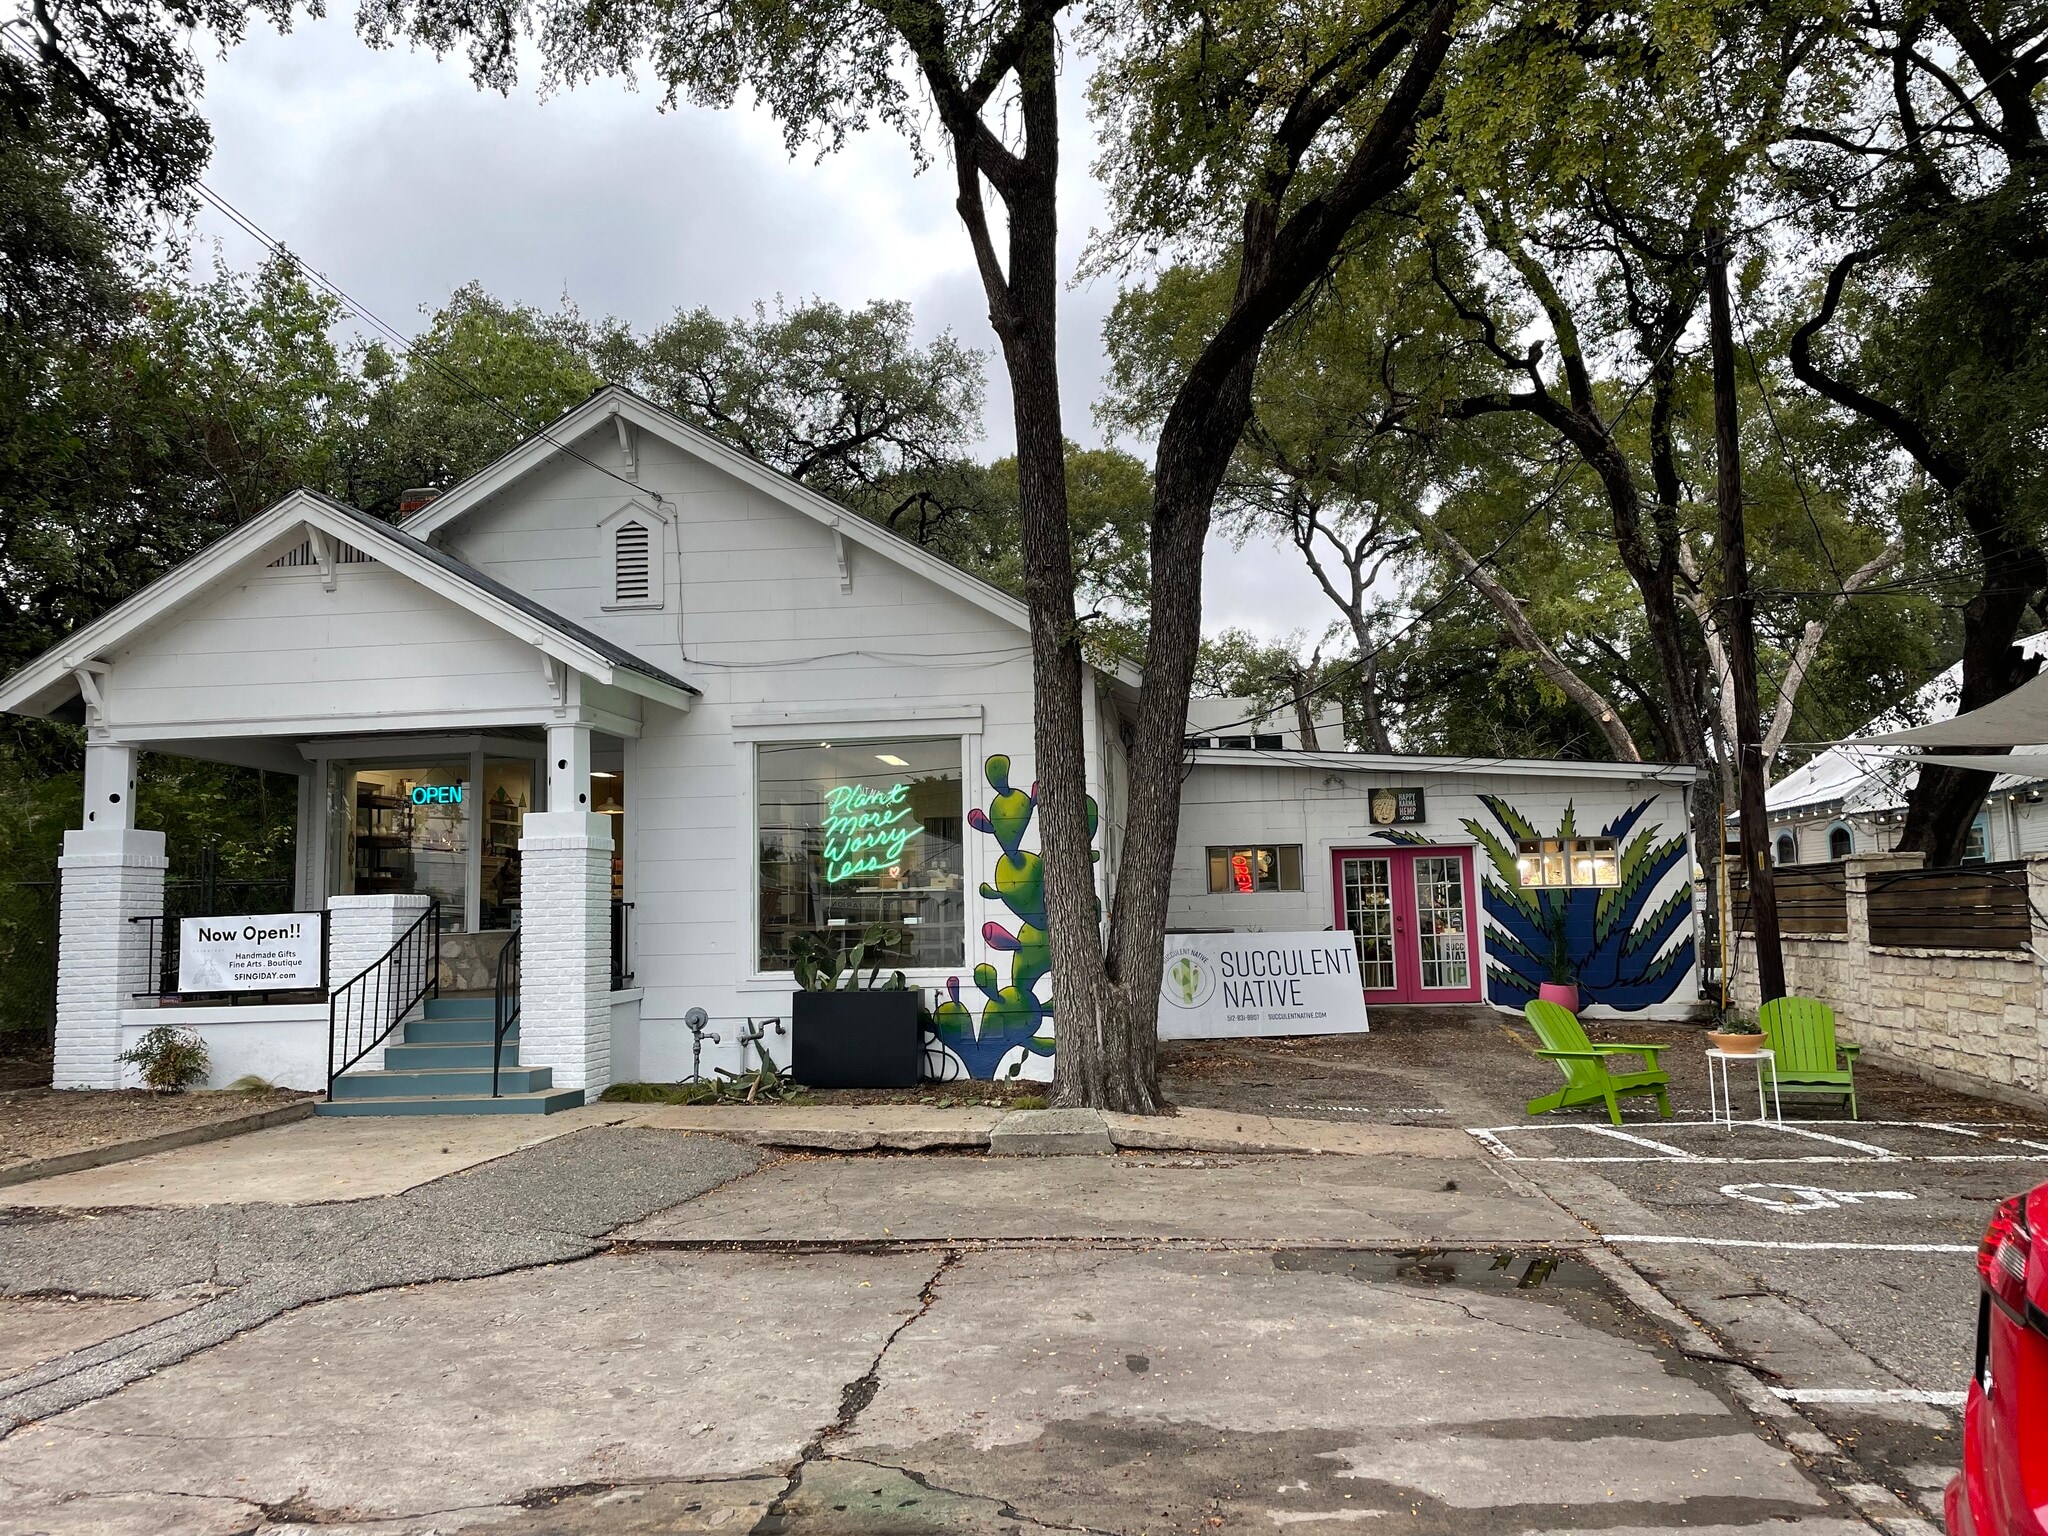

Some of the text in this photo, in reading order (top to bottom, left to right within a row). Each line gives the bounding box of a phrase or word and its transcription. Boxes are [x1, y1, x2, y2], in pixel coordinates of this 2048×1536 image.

[412, 786, 462, 805] OPEN
[823, 783, 911, 815] Plant
[1398, 793, 1416, 801] HAPPY
[1399, 806, 1417, 816] HEMP
[1231, 855, 1254, 893] OPEN
[199, 923, 301, 945] Now Open!!
[235, 951, 277, 960] Handmade
[277, 950, 297, 958] Gifts
[1191, 949, 1210, 964] NATIVE
[229, 959, 303, 969] Fine Arts Boutique
[1220, 948, 1352, 978] SUCCULENT
[234, 971, 296, 981] SFINGIDAY.com
[1223, 979, 1304, 1008] NATIVE
[1267, 1012, 1328, 1021] SUCCULENTNATIVE.COM
